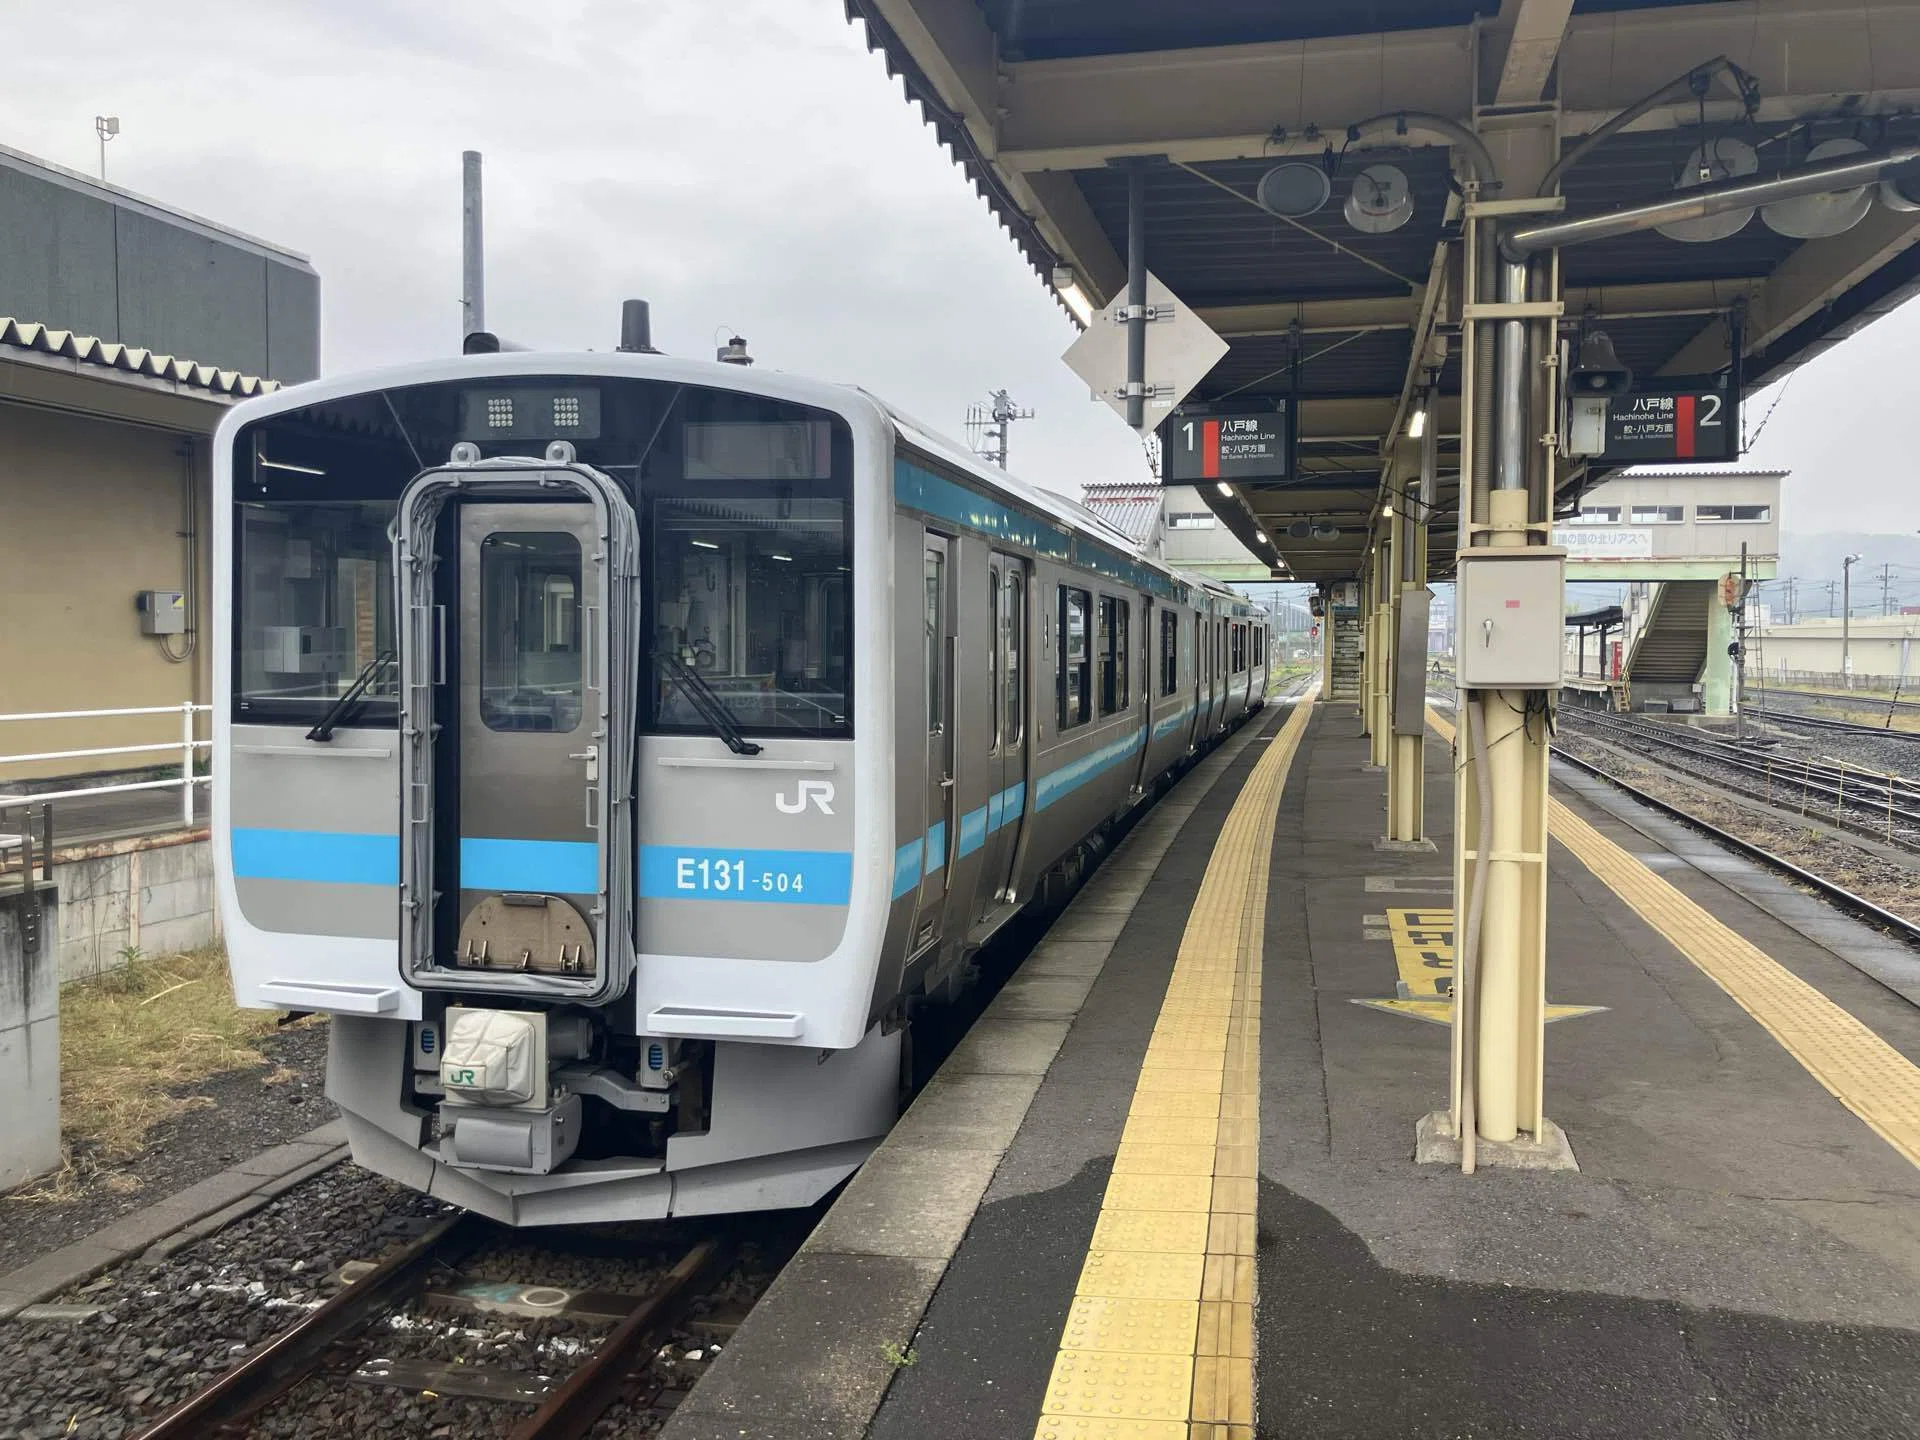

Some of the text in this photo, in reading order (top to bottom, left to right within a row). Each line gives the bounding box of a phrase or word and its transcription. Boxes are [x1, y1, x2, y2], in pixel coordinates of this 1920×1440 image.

[1632, 398, 1674, 411] 八戸線
[1700, 395, 1722, 426] 2
[1613, 412, 1674, 421] Hachinohe Line
[1221, 420, 1258, 433] 八戸線
[1182, 422, 1194, 451] 1
[1221, 432, 1276, 442] Hachinohe Line
[775, 780, 835, 815] JR
[451, 1070, 475, 1085] JR
